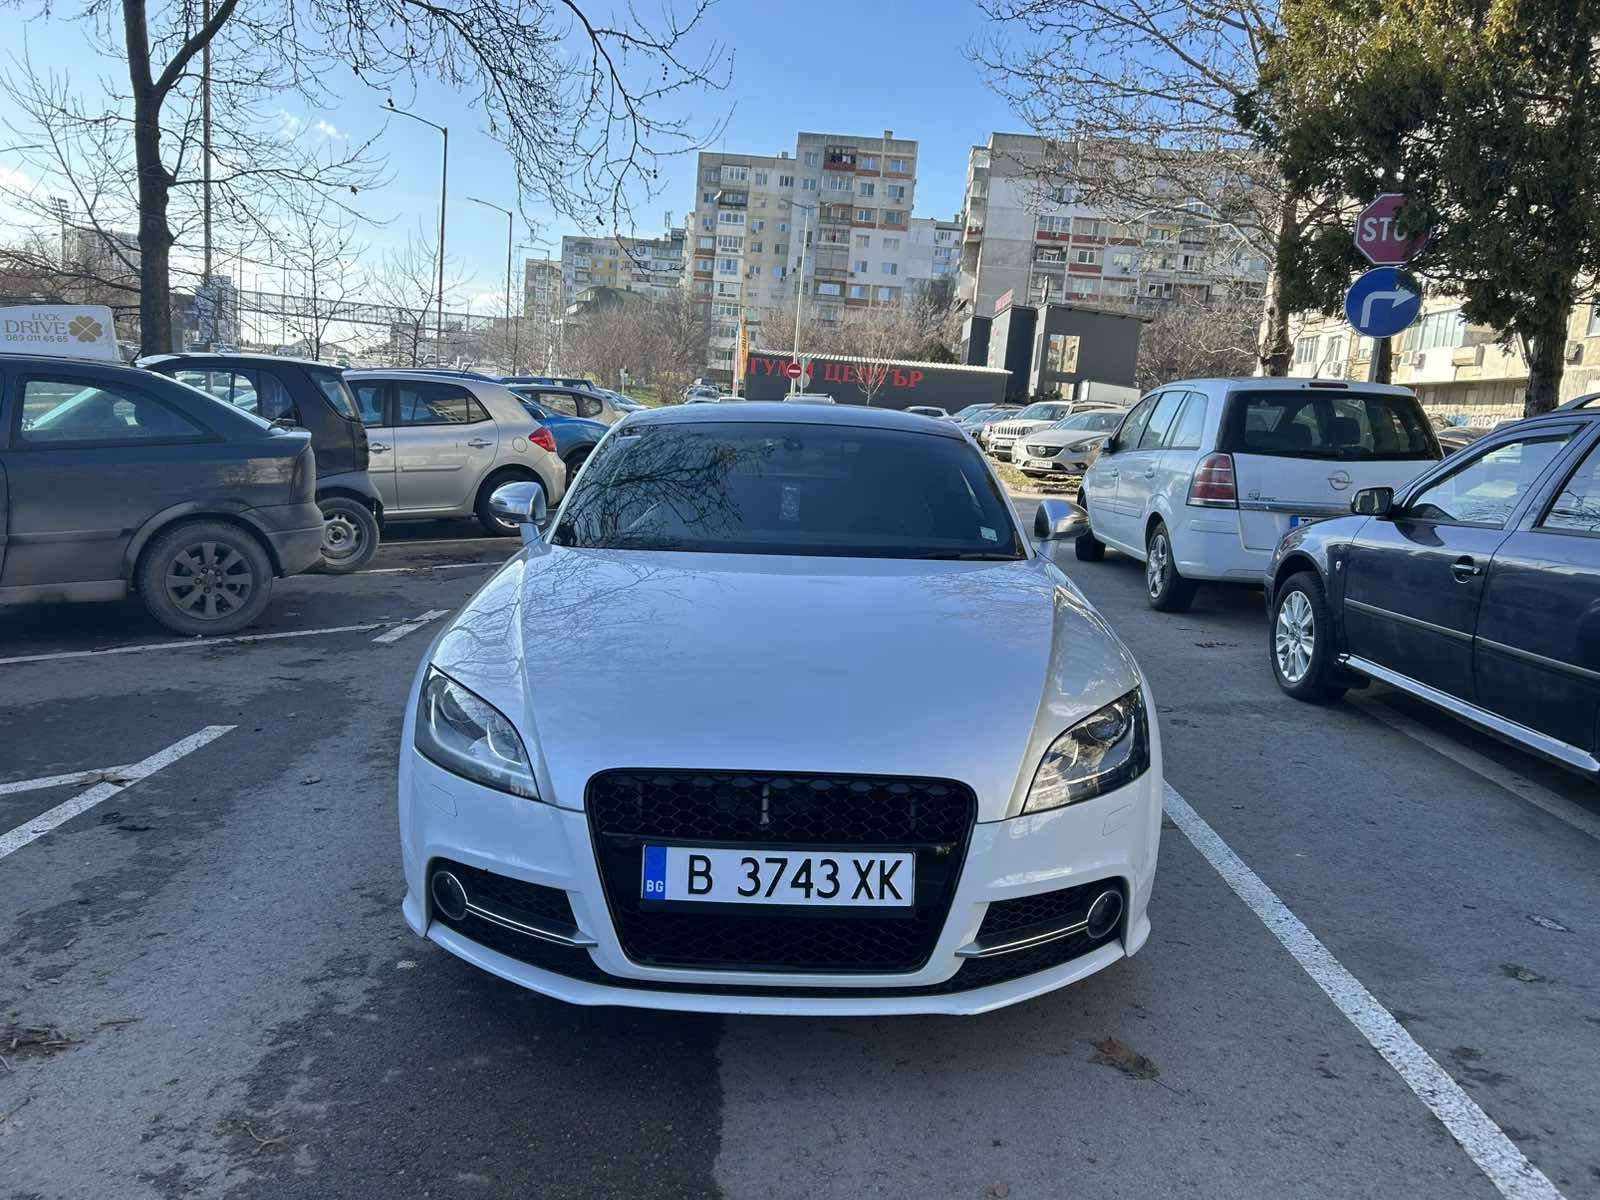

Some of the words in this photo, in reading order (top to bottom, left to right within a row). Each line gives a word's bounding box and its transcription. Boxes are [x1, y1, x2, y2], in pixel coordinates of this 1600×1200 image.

[1362, 217, 1408, 242] STO
[5, 320, 67, 335] DRIVE
[646, 879, 664, 893] BG
[687, 854, 713, 895] B
[737, 857, 841, 899] 3743
[850, 859, 903, 900] XK
